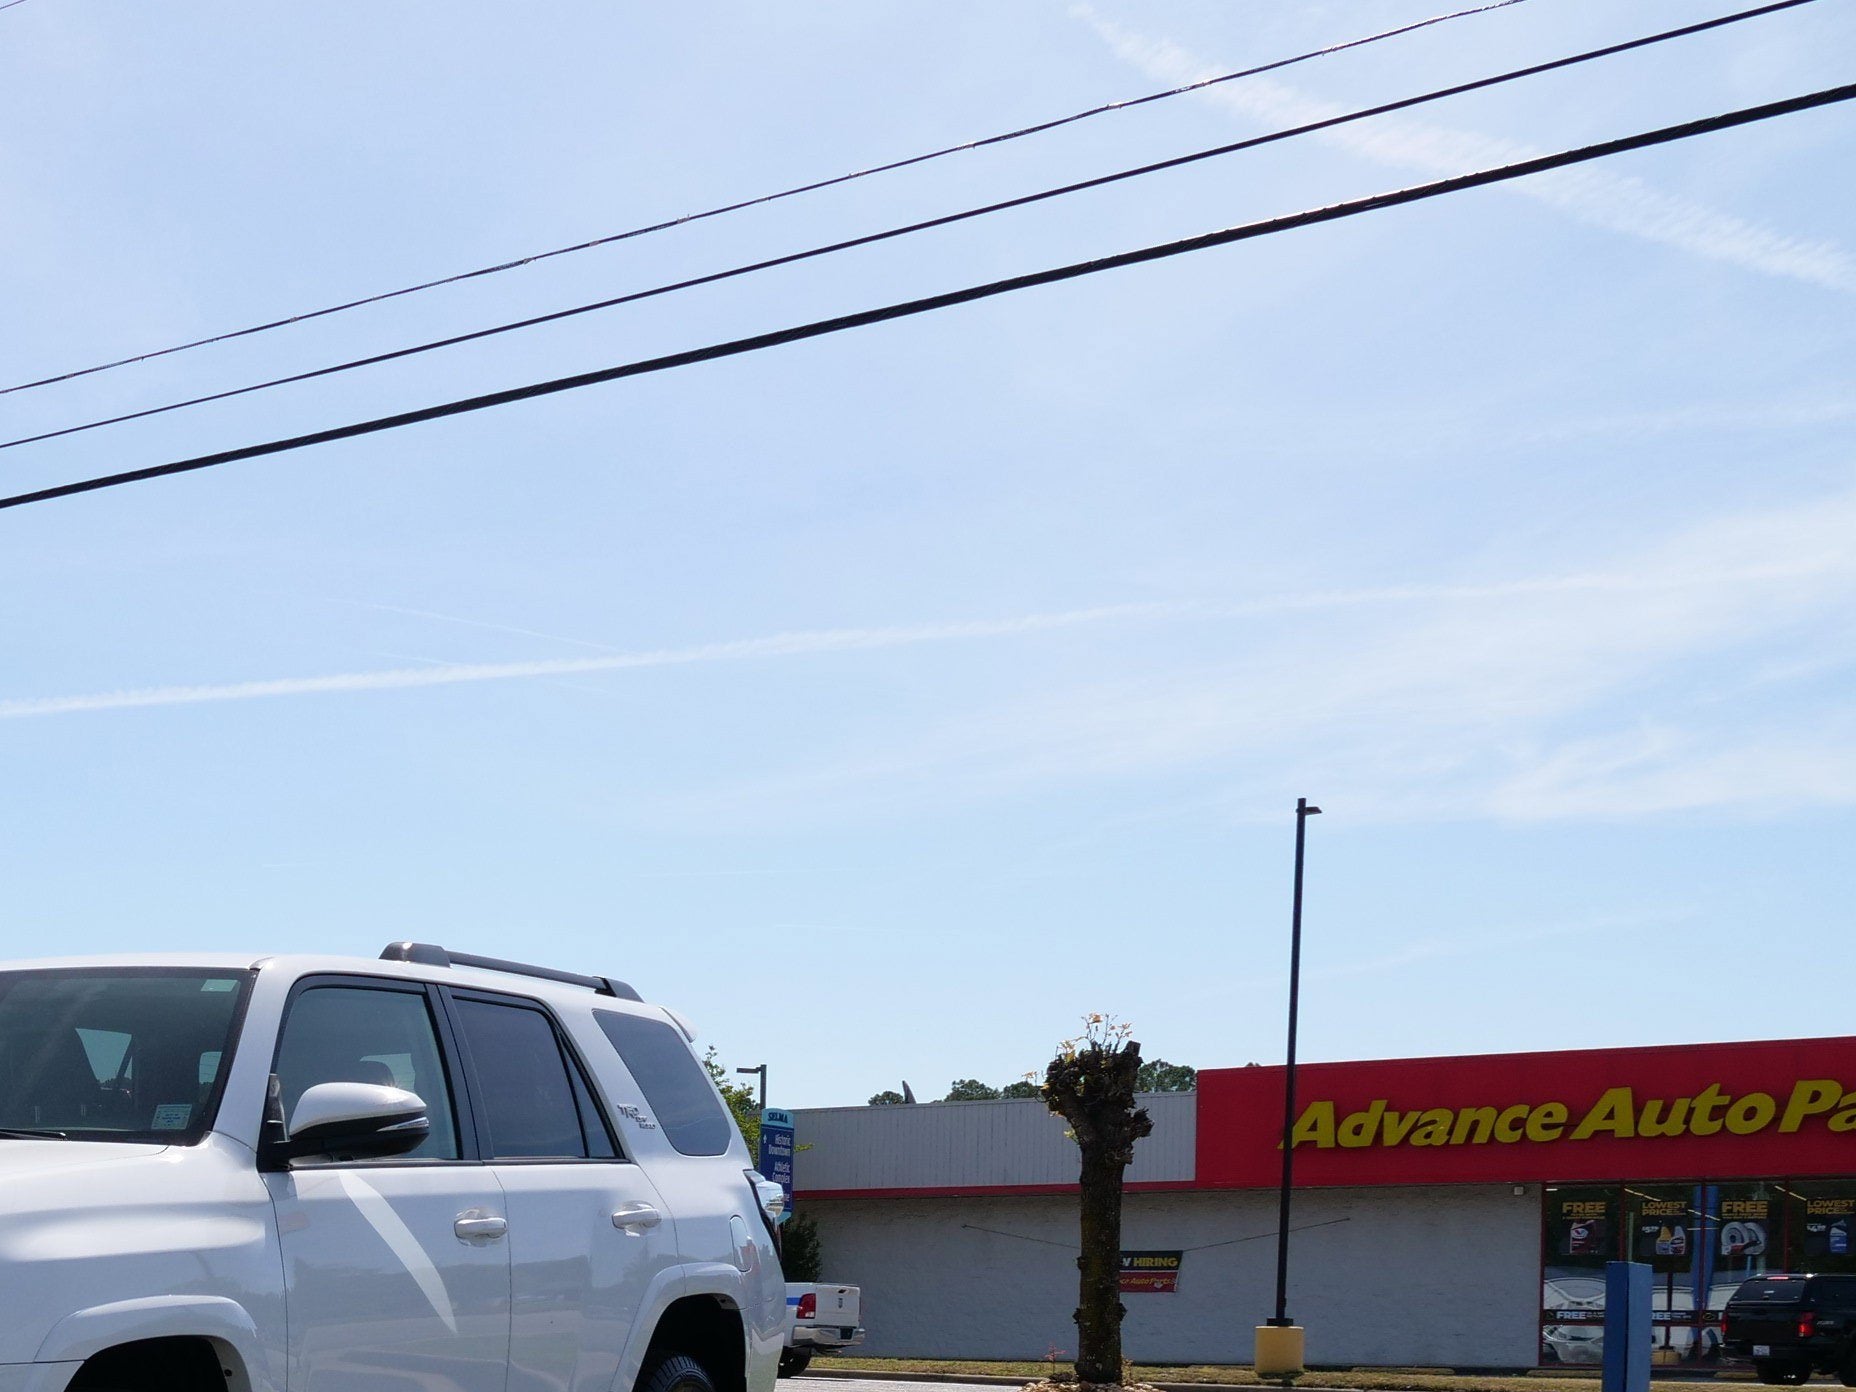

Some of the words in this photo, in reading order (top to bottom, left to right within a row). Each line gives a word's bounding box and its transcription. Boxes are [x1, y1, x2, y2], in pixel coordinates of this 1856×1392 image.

[768, 1112, 788, 1123] SELMA
[1278, 1100, 1568, 1149] Advance
[1569, 1083, 1776, 1140] Auto
[775, 1133, 791, 1146] Historic
[768, 1144, 791, 1157] Downtown
[772, 1172, 790, 1184] Complex
[1562, 1201, 1606, 1213] FREE
[1641, 1201, 1687, 1209] LOWEST
[1721, 1201, 1769, 1213] FREE
[1641, 1208, 1672, 1216] PRICE
[1807, 1207, 1839, 1215] PRICE
[1133, 1257, 1178, 1267] HIRING
[1556, 1311, 1587, 1320] FREE
[1652, 1311, 1671, 1320] REE
